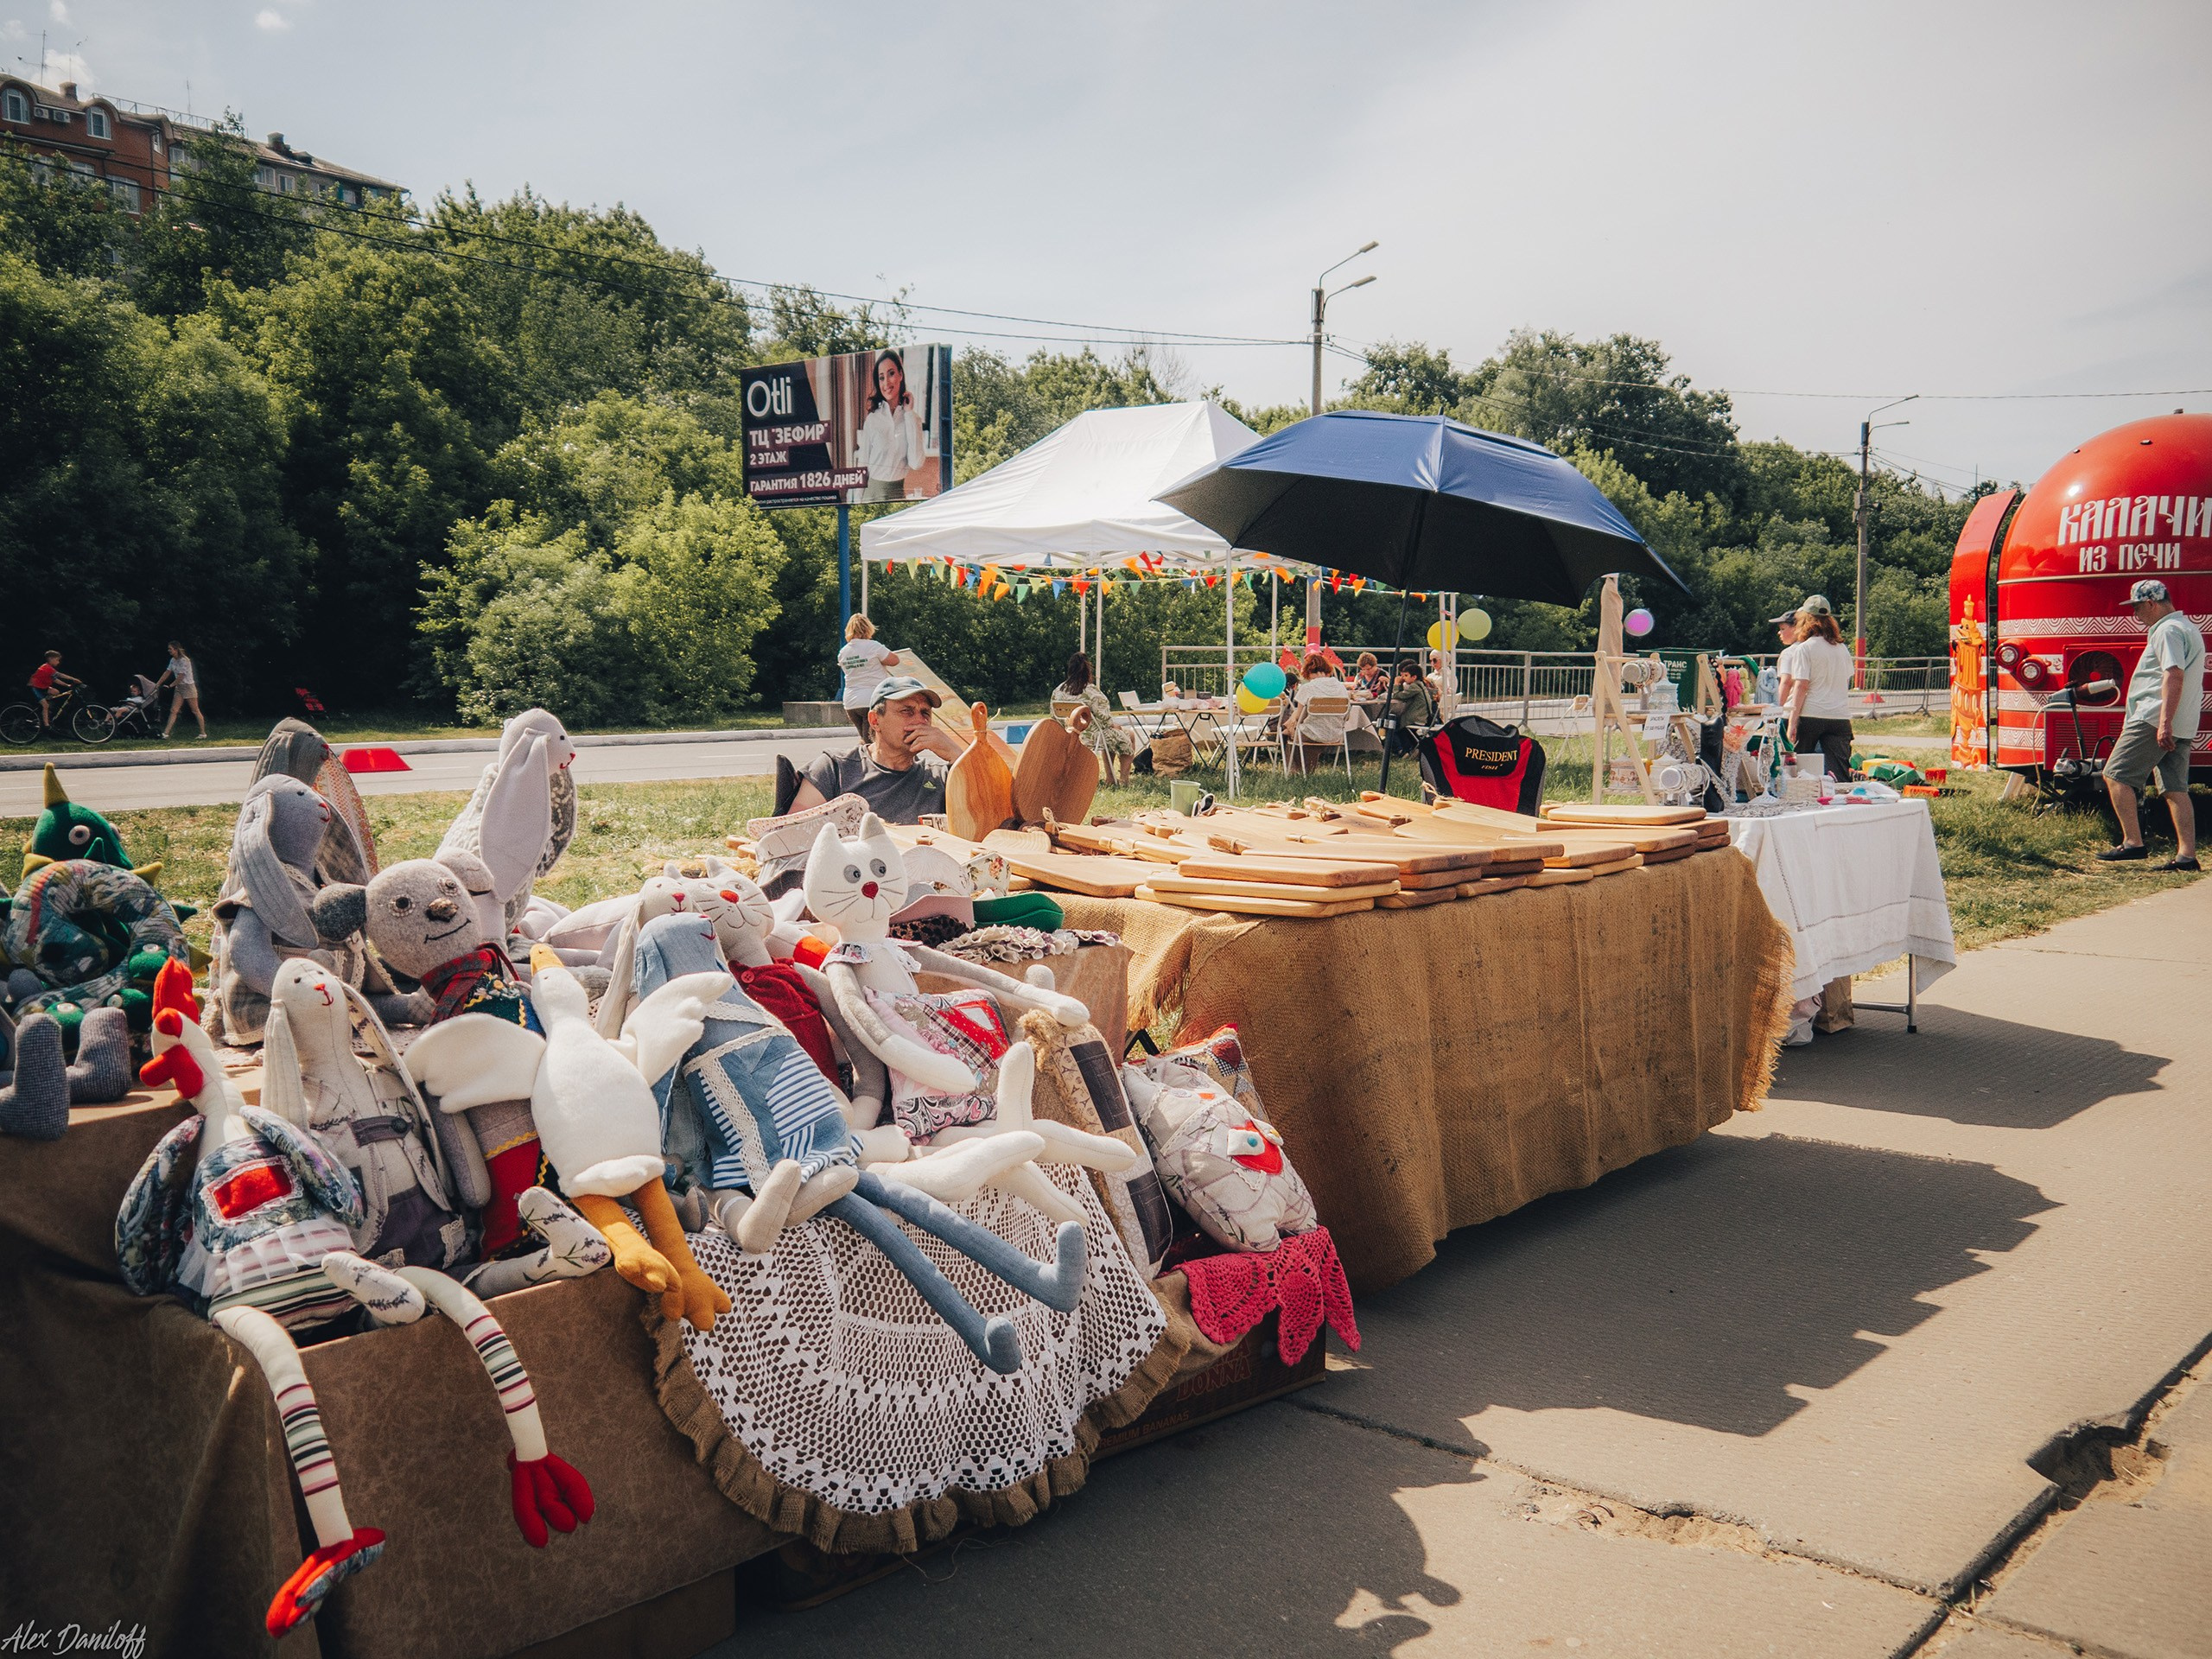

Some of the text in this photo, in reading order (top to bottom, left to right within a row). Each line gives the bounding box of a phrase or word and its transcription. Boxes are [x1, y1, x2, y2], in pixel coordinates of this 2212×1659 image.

[747, 377, 792, 417] Otli
[749, 429, 770, 448] ТЦ
[749, 450, 787, 466] 2 ЭТАЖ
[750, 477, 798, 493] ГАРАНТИЯ
[799, 471, 831, 488] 1826
[2079, 543, 2181, 573] ИЗ ПЕЧИ
[1465, 747, 1518, 762] PRESIDENT
[1176, 1356, 1251, 1402] DONNA
[1096, 1410, 1190, 1449] REMIUM BANANAS
